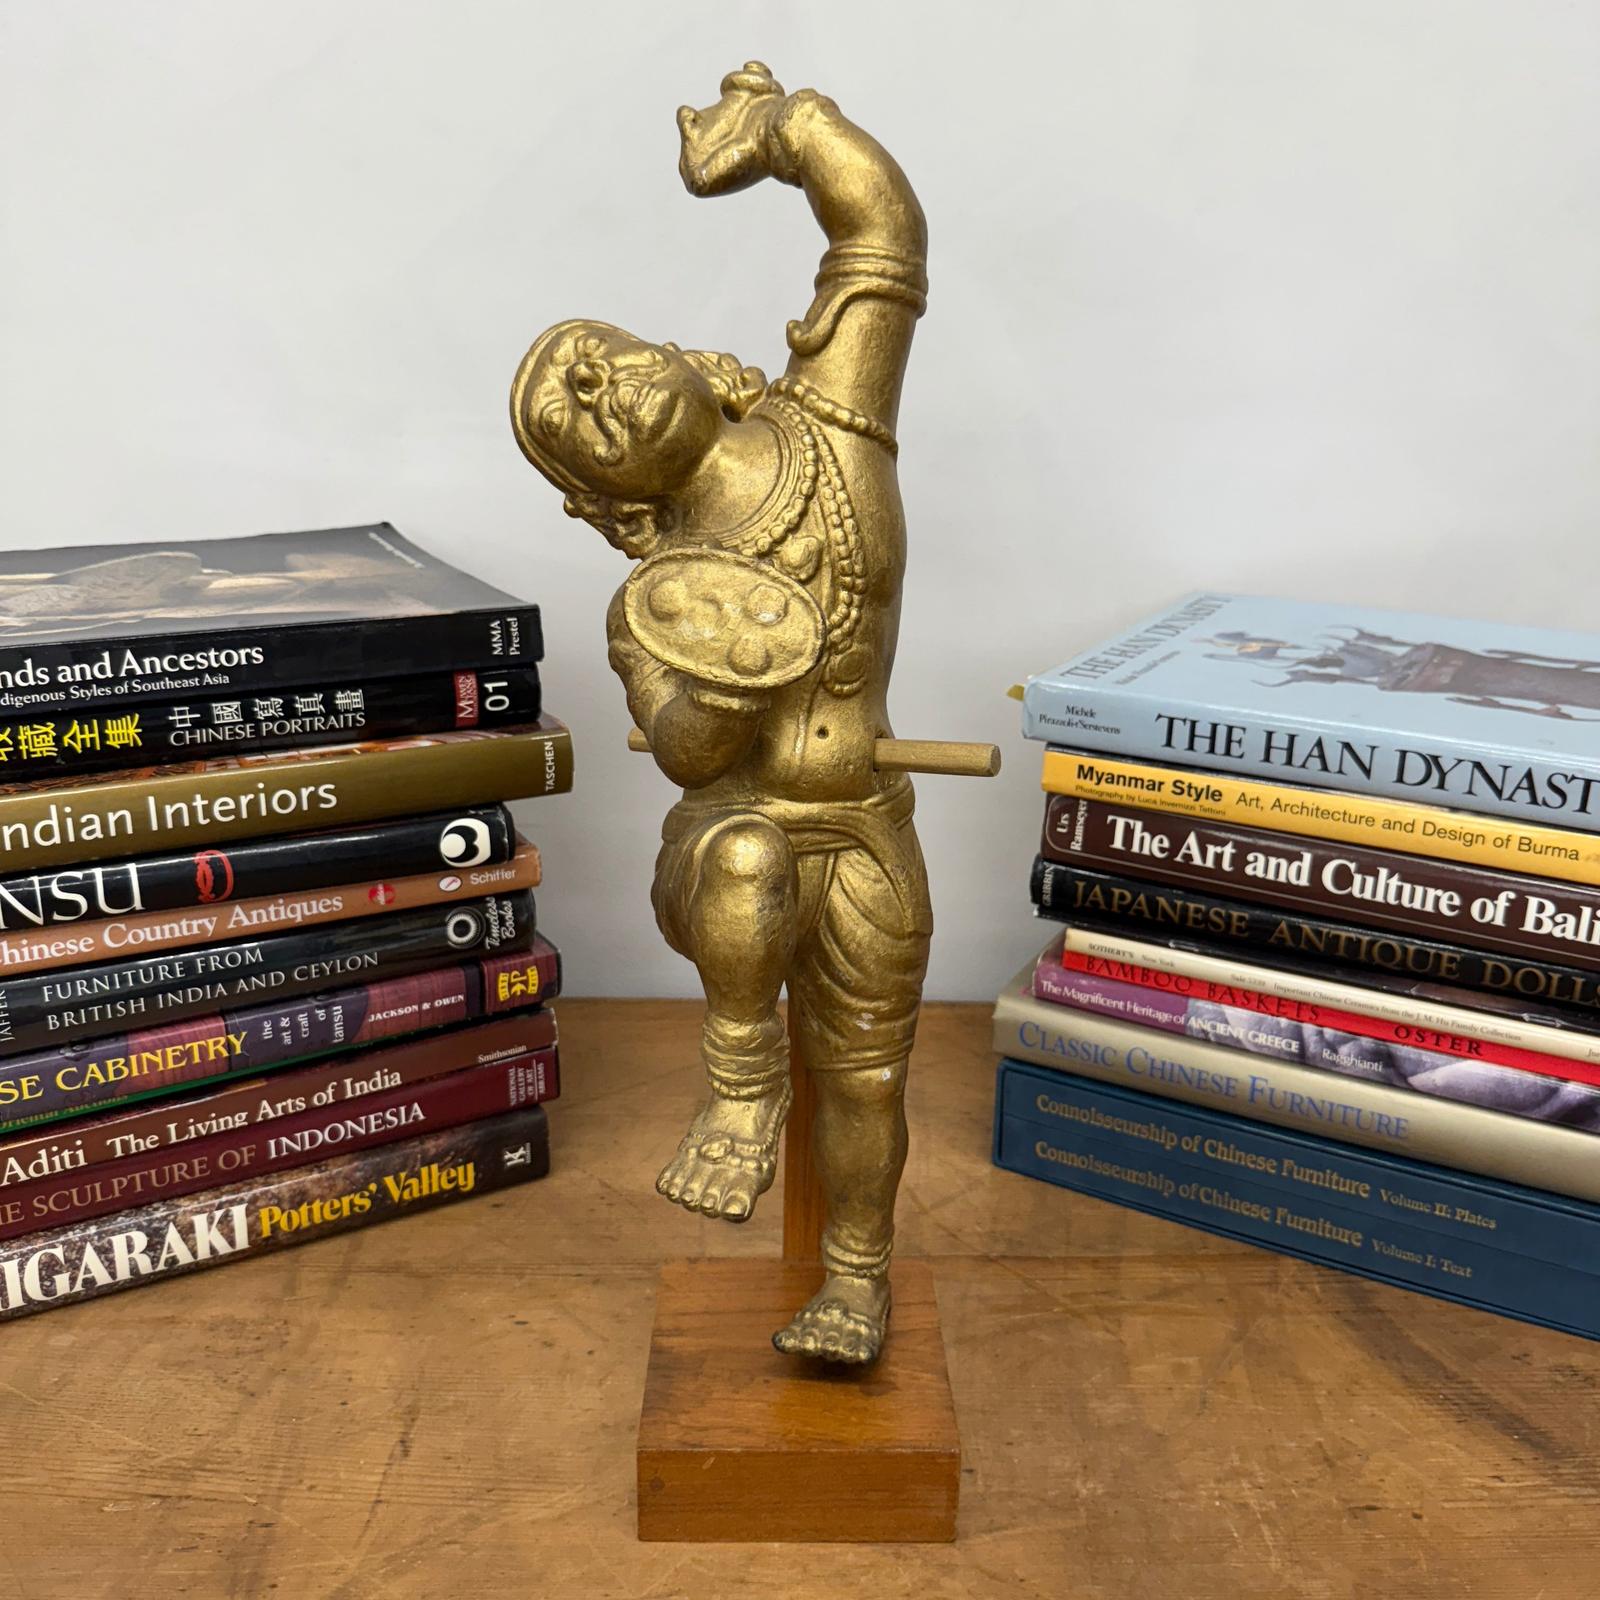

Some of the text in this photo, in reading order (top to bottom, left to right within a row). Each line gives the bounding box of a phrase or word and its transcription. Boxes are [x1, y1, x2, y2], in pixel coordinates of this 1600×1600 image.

[489, 620, 504, 655] MMA
[506, 617, 521, 655] Prestel
[0, 646, 265, 689] nds and Ancestors
[0, 672, 230, 709] digenous Styles of Southeast Asia
[484, 681, 510, 712] 01
[170, 712, 366, 746] CHINESE PORTRAITS
[545, 741, 555, 792] TASCHEN
[1154, 713, 1600, 815] THE HAN DYNAST
[2, 782, 338, 851] ndian Interiors
[1075, 784, 1126, 802] Photography
[1126, 791, 1136, 803] by
[1137, 794, 1158, 807] Luca
[1076, 764, 1580, 862] Myanmar Style Art, Architecture and Design of Burma
[1056, 812, 1071, 833] Urs
[0, 862, 146, 930] NSU
[470, 869, 516, 885] Schiffer
[1106, 814, 1600, 946] The Art and Culture of Bali
[0, 896, 344, 966] hinese Country Antiques
[500, 900, 516, 939] Books
[1073, 880, 1600, 1008] JAPANESE ANTIQUE DOLL
[43, 948, 265, 1002] FURNITURE FROM
[47, 952, 379, 1031] BRITISH INDIA AND CEYLON
[1086, 955, 1320, 1022] BAMBOO BASKETS
[262, 1020, 273, 1039] the
[280, 1016, 292, 1045] art &
[297, 1012, 310, 1038] craft
[315, 1008, 327, 1021] of
[333, 1005, 344, 1043] tansu
[368, 994, 465, 1022] JACKSON & OWEN
[1041, 979, 1384, 1073] The Magnificent Heritage of ANCIENT GREECE Ragghianti
[1451, 1020, 1480, 1034] Family
[1480, 1027, 1522, 1042] Collection
[478, 1045, 527, 1063] Smithsonian
[1394, 1025, 1483, 1056] OSTER
[0, 1032, 248, 1105] SE CABINETRY
[1018, 1020, 1409, 1139] CLASSIC CHINESE FURNITURE
[1, 1068, 402, 1187] Aditi The Living Arts of India
[0, 1102, 426, 1226] E SCULPTURE OF INDONESIA
[1036, 1094, 1497, 1230] Connoisseurship of Chinese Furniture Volume II: Plates
[1034, 1141, 1473, 1278] Connoisseurship of Chinese Furniture Volume I: Text
[0, 1161, 475, 1312] IGARAKI Potters' Valley
